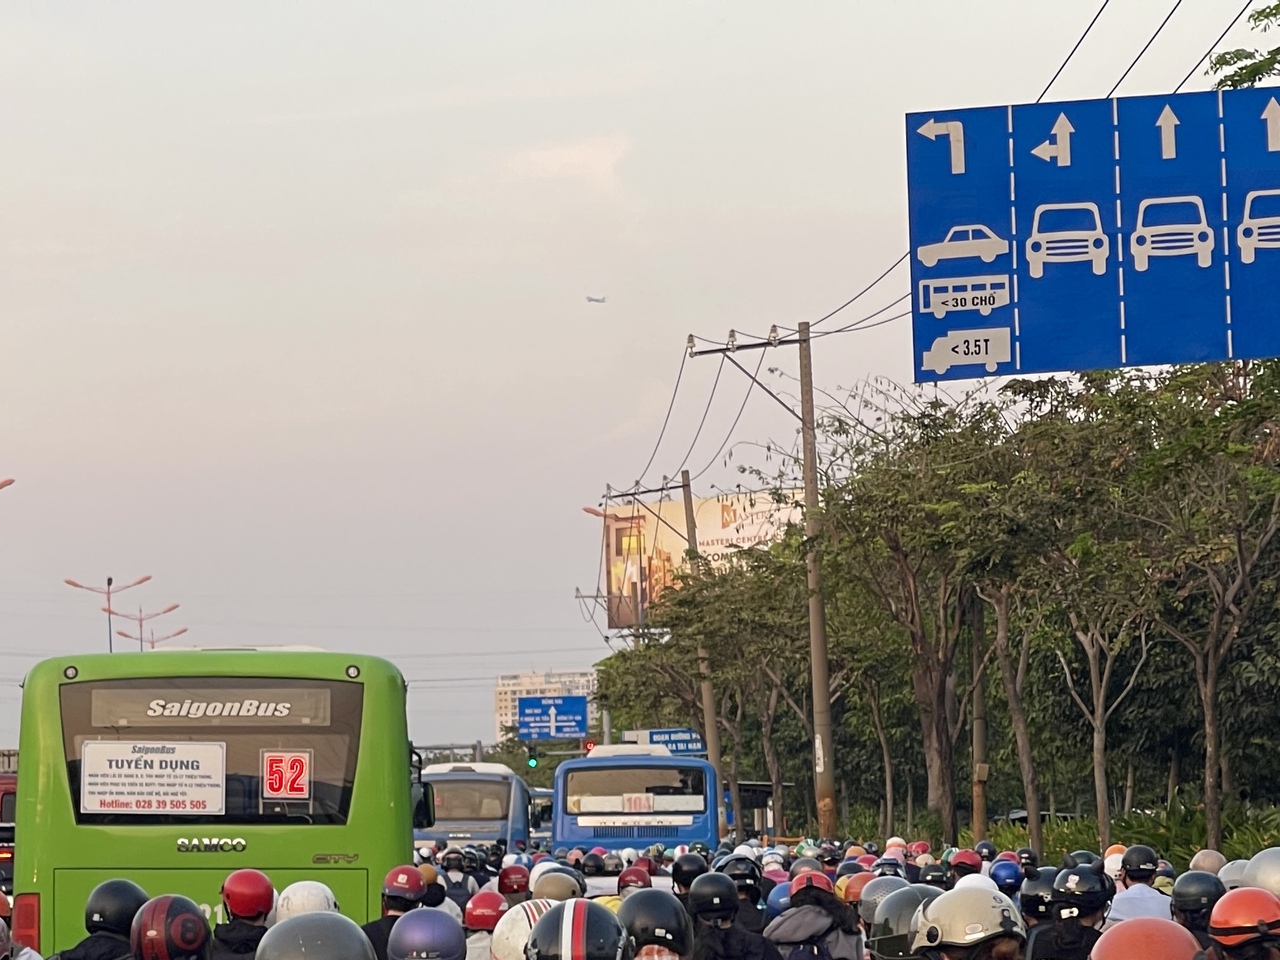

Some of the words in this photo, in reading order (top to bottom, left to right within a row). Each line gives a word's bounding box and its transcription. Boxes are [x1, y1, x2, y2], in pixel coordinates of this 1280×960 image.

[952, 297, 967, 307] 30
[147, 700, 291, 718] SaigonBus
[131, 745, 176, 755] SaigonBus
[107, 755, 154, 769] TUYỂN
[159, 760, 200, 772] DỤNG
[266, 756, 307, 794] 52
[100, 799, 133, 809] Hotline:
[135, 800, 152, 809] 028
[156, 800, 166, 809] 39
[170, 800, 186, 809] 505
[190, 800, 207, 809] 505
[177, 838, 247, 852] SAMCO
